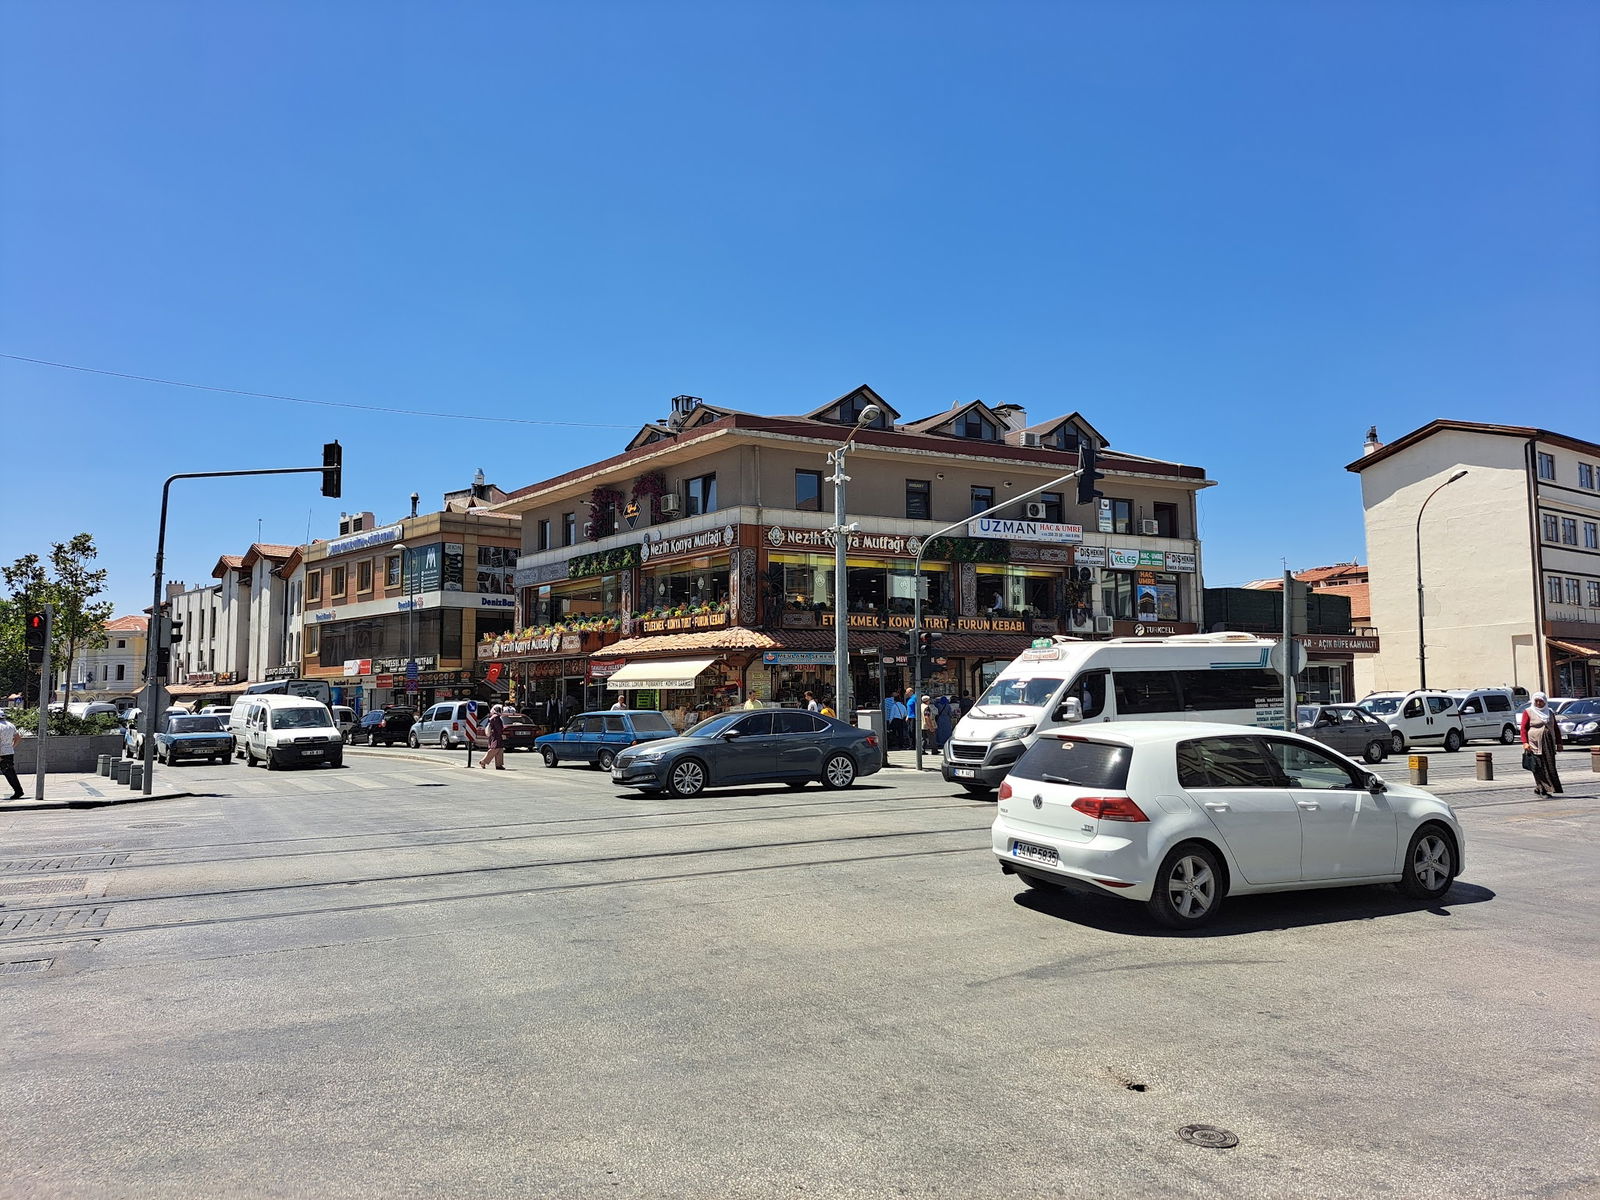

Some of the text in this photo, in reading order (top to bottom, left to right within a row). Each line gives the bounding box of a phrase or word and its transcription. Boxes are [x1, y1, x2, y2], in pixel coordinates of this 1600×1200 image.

[980, 519, 1037, 534] UZMAN
[1039, 523, 1054, 532] HAC
[1062, 525, 1081, 533] UMRE
[650, 530, 721, 556] Nezih Konya Mutfağı
[787, 530, 821, 545] Nezih
[862, 535, 904, 554] Mutfağı
[924, 617, 949, 629] TİRİT
[958, 619, 990, 630] FURUN
[992, 620, 1025, 632] KEBABI
[1146, 626, 1176, 634] TURKCELL
